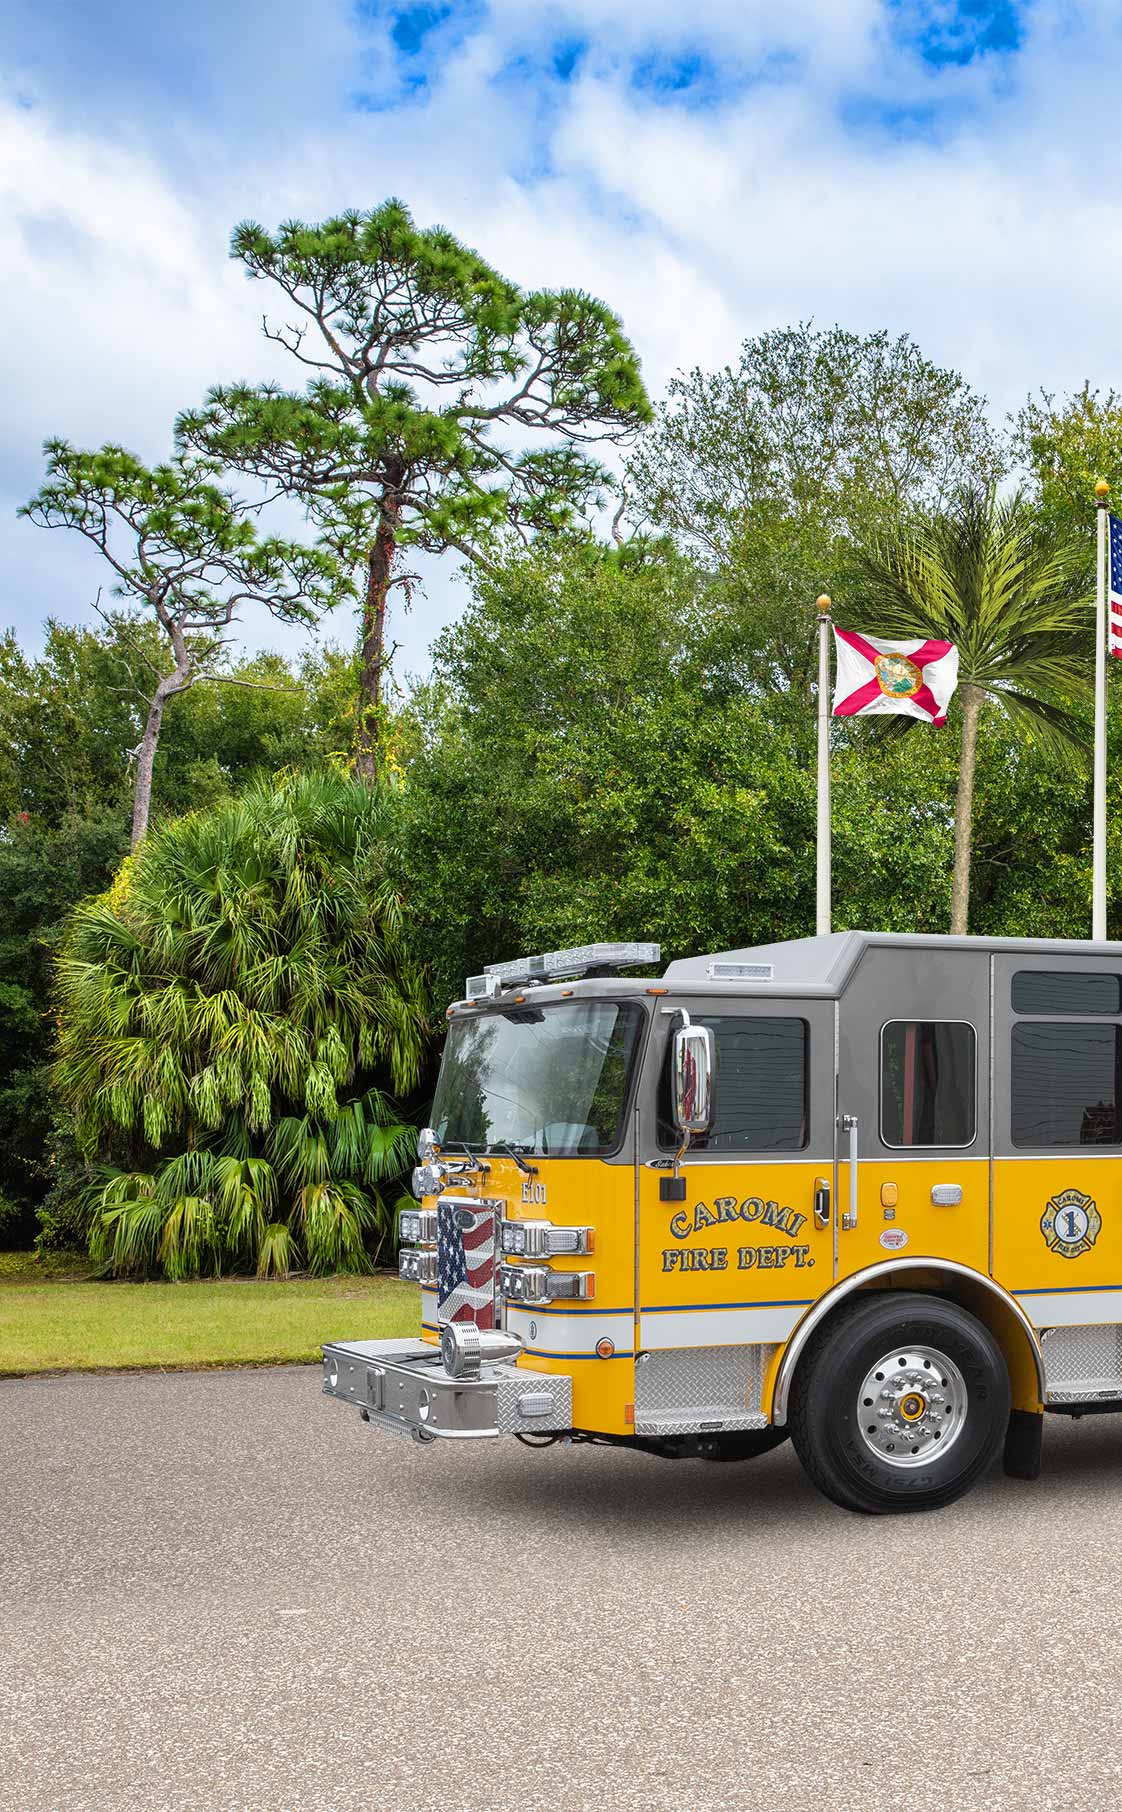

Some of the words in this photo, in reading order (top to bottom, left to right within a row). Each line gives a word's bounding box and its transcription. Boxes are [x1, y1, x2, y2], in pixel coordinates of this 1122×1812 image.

[521, 1183, 547, 1204] E101
[670, 1196, 807, 1239] CAROMI
[1065, 1211, 1076, 1237] 1
[662, 1248, 728, 1272] FIRE
[737, 1245, 816, 1270] DEPT.
